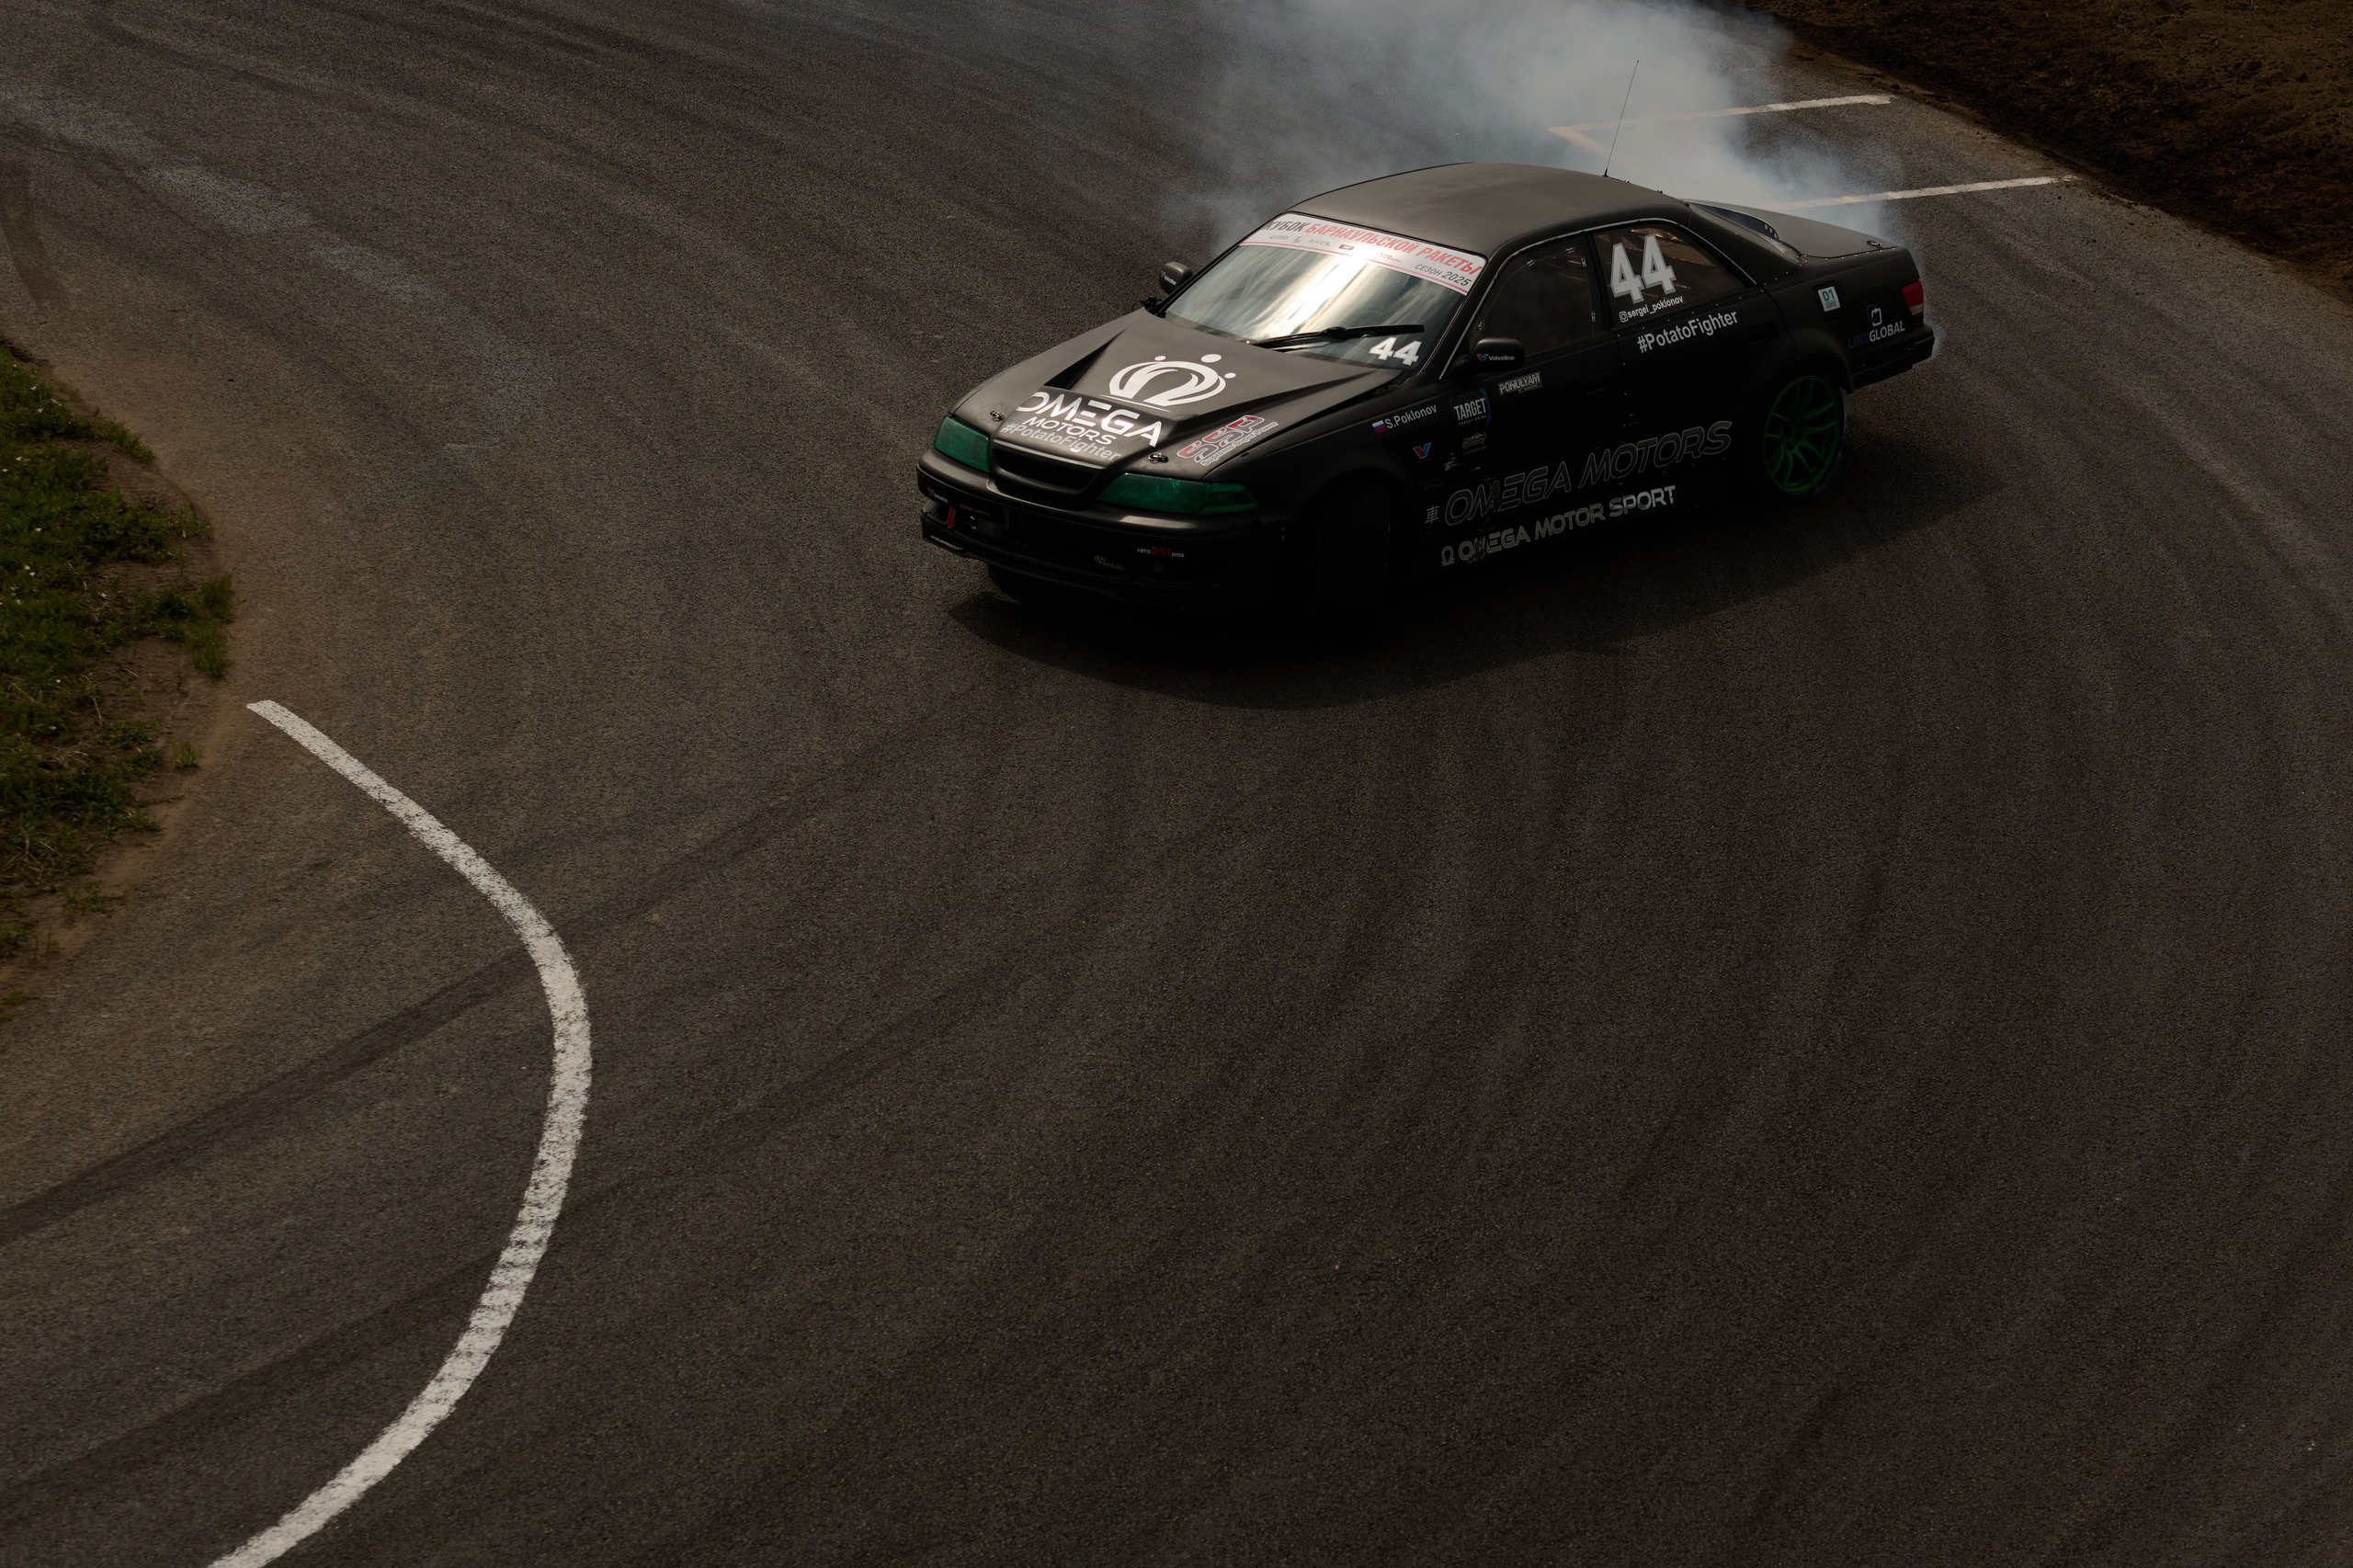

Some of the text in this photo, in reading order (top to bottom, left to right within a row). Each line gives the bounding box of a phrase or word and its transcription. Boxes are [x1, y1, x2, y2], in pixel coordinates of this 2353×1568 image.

[1304, 223, 1421, 254] БАРНАУЛЬСКОЙ
[1415, 247, 1483, 275] РАКЕТЫ
[1415, 264, 1472, 287] СЕЗОН 2025
[1610, 233, 1677, 304] 44
[1822, 289, 1835, 301] D1
[1637, 312, 1739, 353] #PotatoFighter
[1369, 337, 1422, 366] 44
[1016, 392, 1163, 449] OMEGA
[1385, 404, 1437, 429] S.Poklonov
[1454, 398, 1487, 421] TARGET
[1000, 423, 1121, 460] #PotatoFighter
[1022, 416, 1117, 445] MOTORS
[1445, 420, 1733, 526] OMEGA MOTORS
[1534, 503, 1607, 540] MOTOR
[1608, 484, 1676, 517] SPORT
